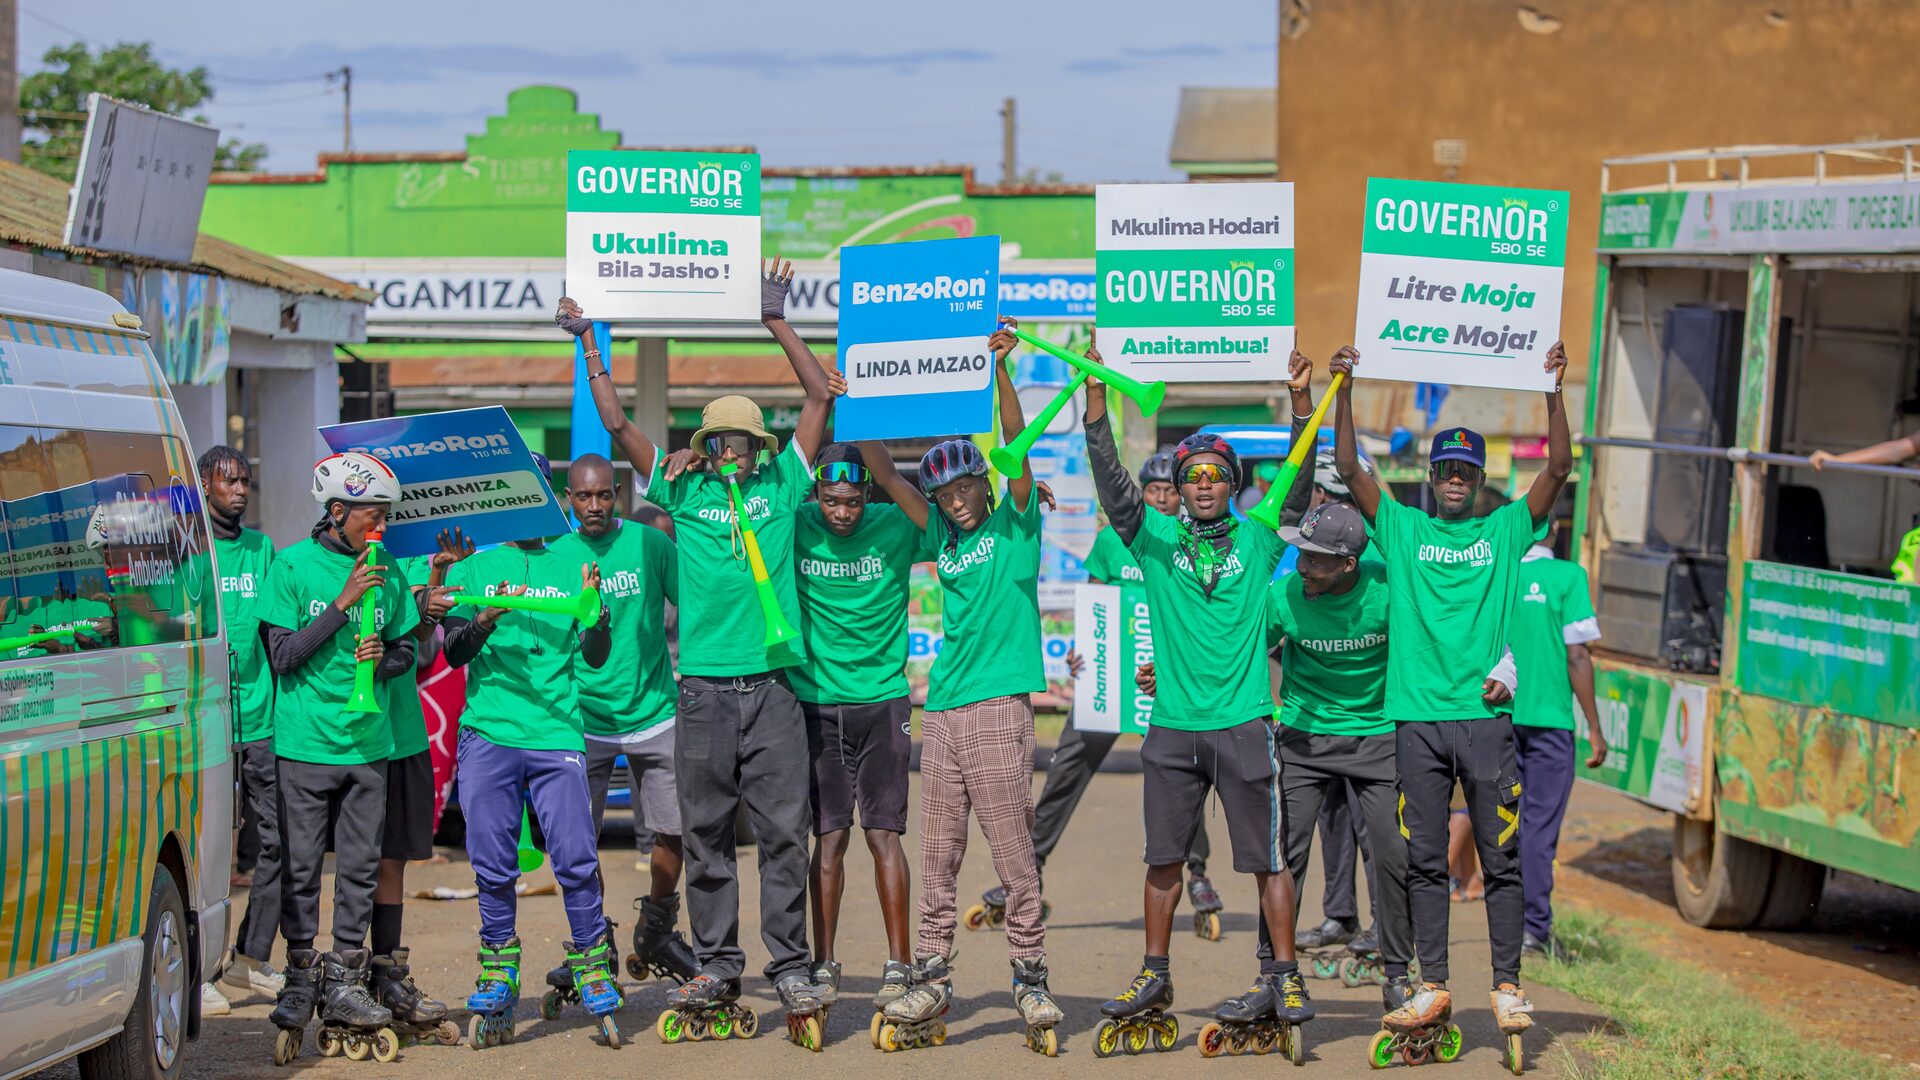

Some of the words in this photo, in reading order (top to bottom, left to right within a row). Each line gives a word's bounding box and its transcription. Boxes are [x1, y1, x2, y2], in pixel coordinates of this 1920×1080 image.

[577, 166, 742, 196] GOVERNOR
[690, 198, 719, 207] 580
[724, 198, 742, 208] SE
[1111, 217, 1205, 236] Mkulima
[1208, 215, 1279, 235] Hodari
[1375, 197, 1548, 242] GOVERNOR
[592, 231, 728, 256] Ukulima
[1491, 242, 1521, 255] 580
[1526, 244, 1546, 257] SE
[598, 260, 644, 278] Bila
[1105, 269, 1276, 303] GOVERNOR
[1388, 276, 1457, 302] Litre
[1461, 283, 1536, 312] Moja
[949, 302, 964, 312] 110
[967, 300, 983, 310] ME
[1221, 304, 1251, 316] 580
[1257, 304, 1276, 316] SE
[1121, 335, 1269, 355] Anaitambua!
[1379, 319, 1449, 344] Acre
[1453, 324, 1538, 354] Moja!
[856, 360, 912, 378] LINDA
[918, 355, 986, 374] MAZAO
[471, 450, 489, 459] 110
[492, 447, 512, 456] ME
[400, 479, 511, 502] ANGAMIZA
[385, 508, 426, 522] FALL
[430, 494, 543, 517] ARMYWORMS
[1419, 541, 1492, 563] GOVERNOR
[1471, 559, 1485, 567] 580
[128, 552, 175, 587] Ambulance
[800, 556, 882, 577] GOVERNOR
[857, 574, 872, 582] 580
[1092, 603, 1107, 641] Safi!
[1301, 634, 1386, 653] GOVERNOR
[1094, 645, 1107, 713] Shamba
